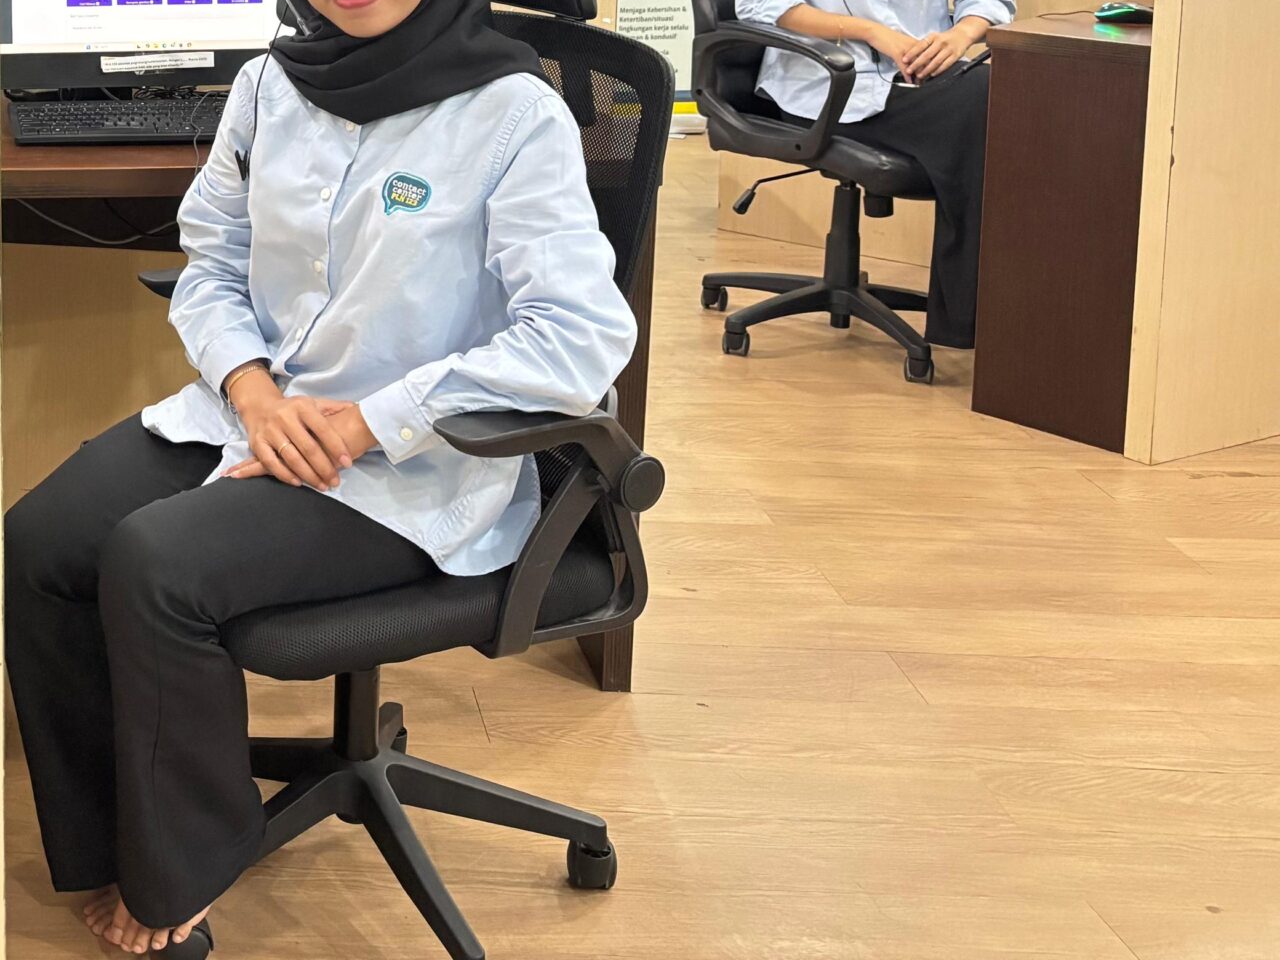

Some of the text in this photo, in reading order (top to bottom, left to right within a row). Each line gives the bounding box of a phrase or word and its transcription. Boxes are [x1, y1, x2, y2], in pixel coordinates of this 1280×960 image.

[392, 179, 427, 196] contact
[392, 186, 422, 201] center
[391, 192, 418, 206] PLN 123
